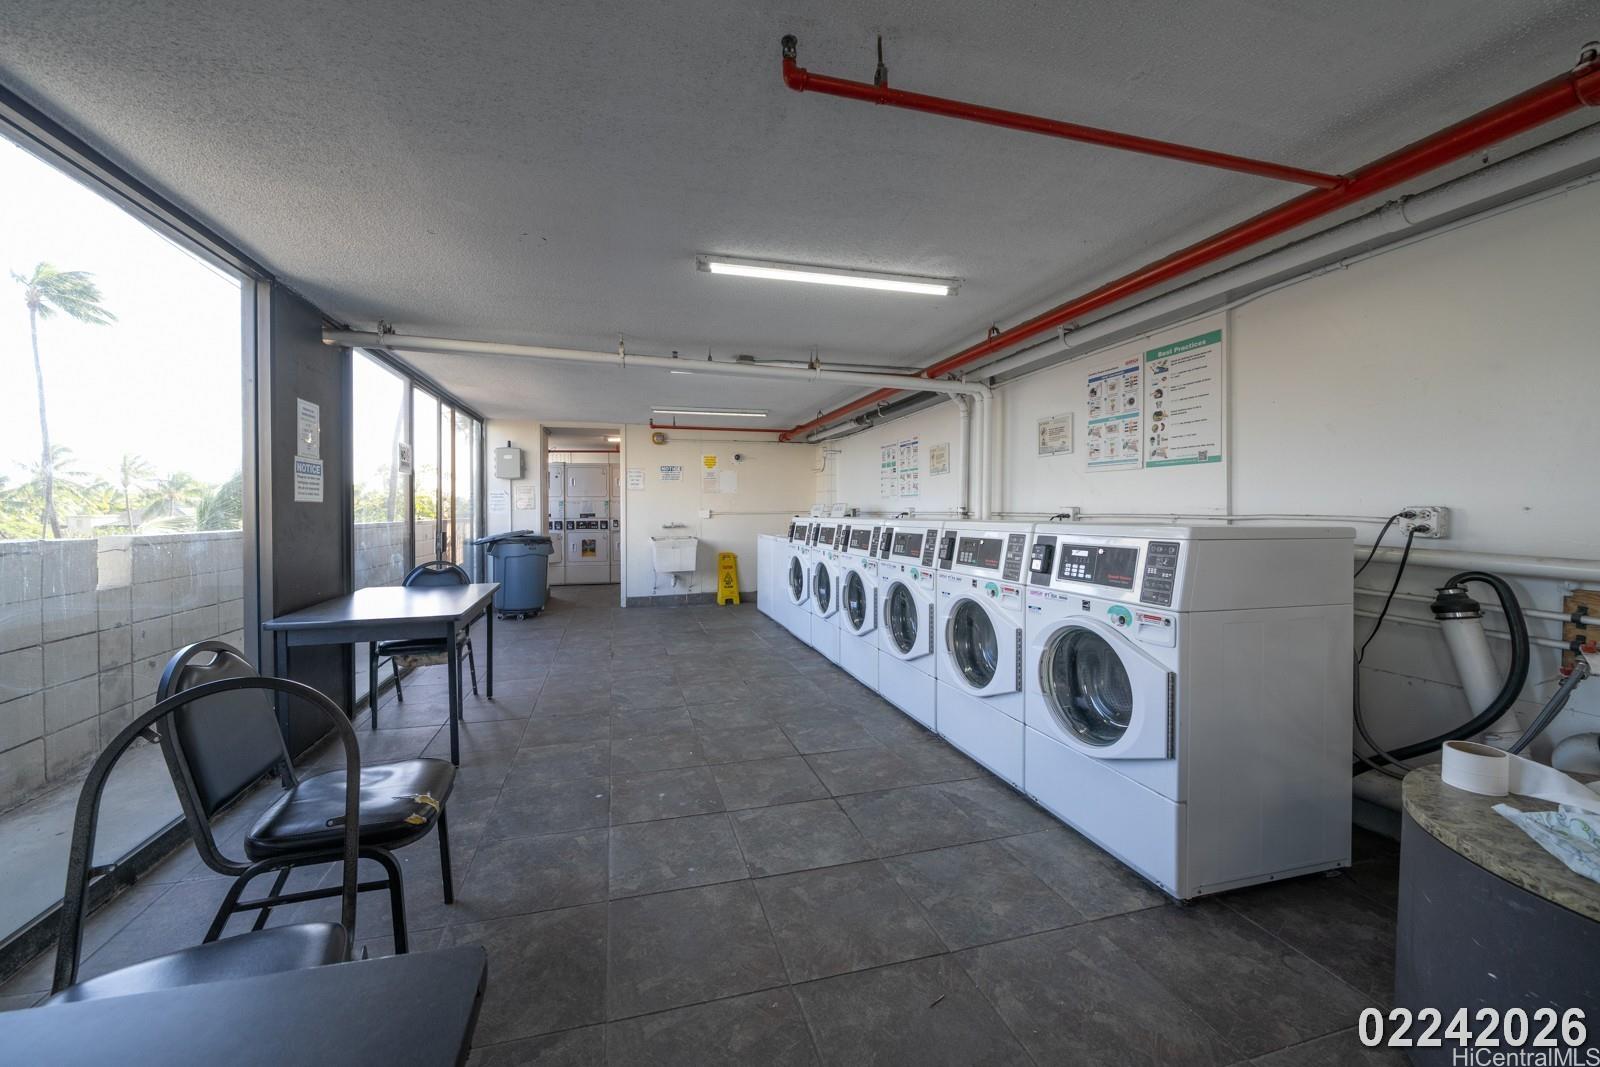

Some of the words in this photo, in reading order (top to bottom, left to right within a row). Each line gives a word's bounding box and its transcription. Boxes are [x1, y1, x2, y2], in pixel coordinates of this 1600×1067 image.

[1157, 347, 1173, 358] Best
[1174, 339, 1207, 353] Practices
[296, 462, 321, 474] NOTICE
